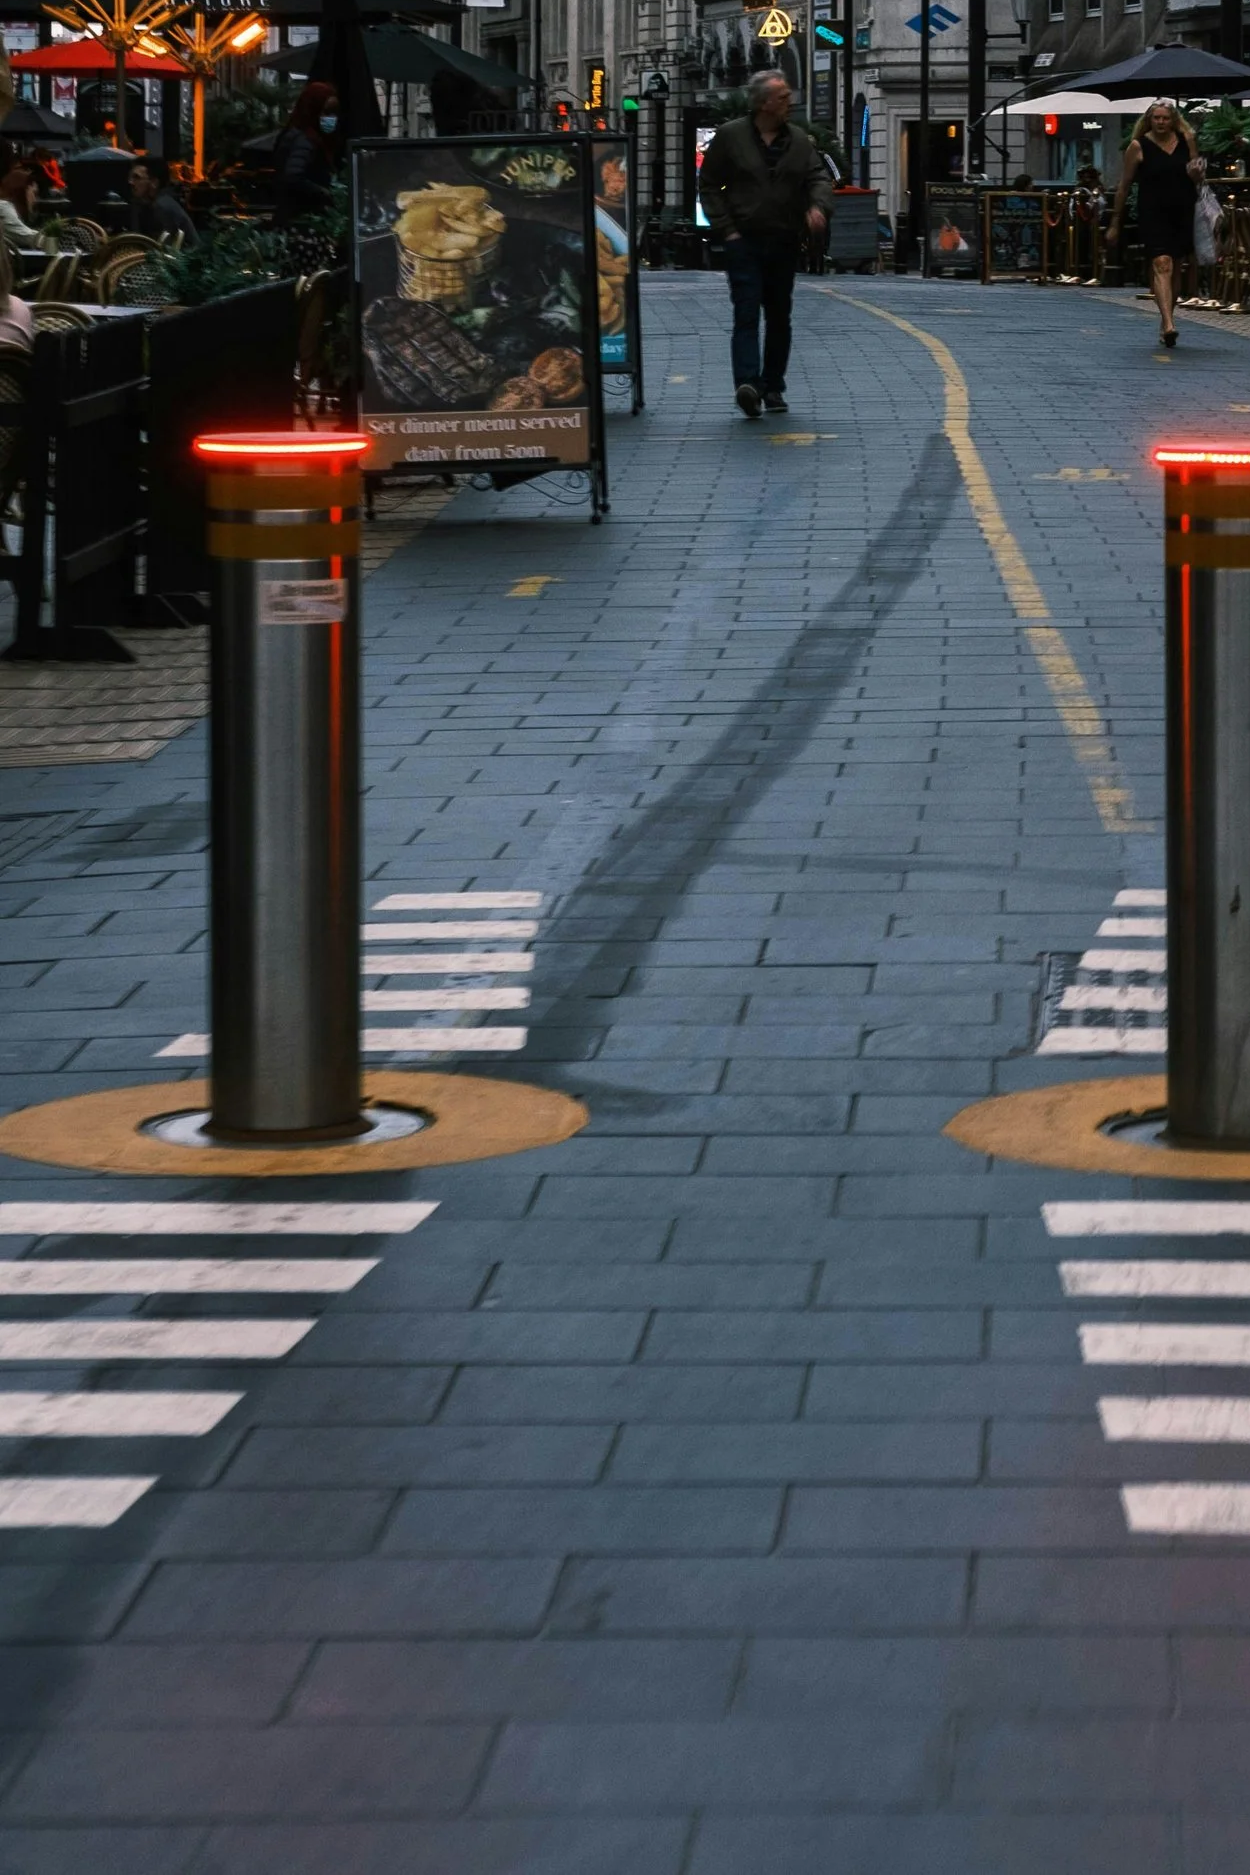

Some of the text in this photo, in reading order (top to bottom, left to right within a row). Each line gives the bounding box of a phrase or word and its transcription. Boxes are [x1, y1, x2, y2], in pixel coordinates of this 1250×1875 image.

[500, 153, 577, 185] JUNIPER
[367, 412, 581, 435] Set dinner menu served
[455, 444, 500, 462] from
